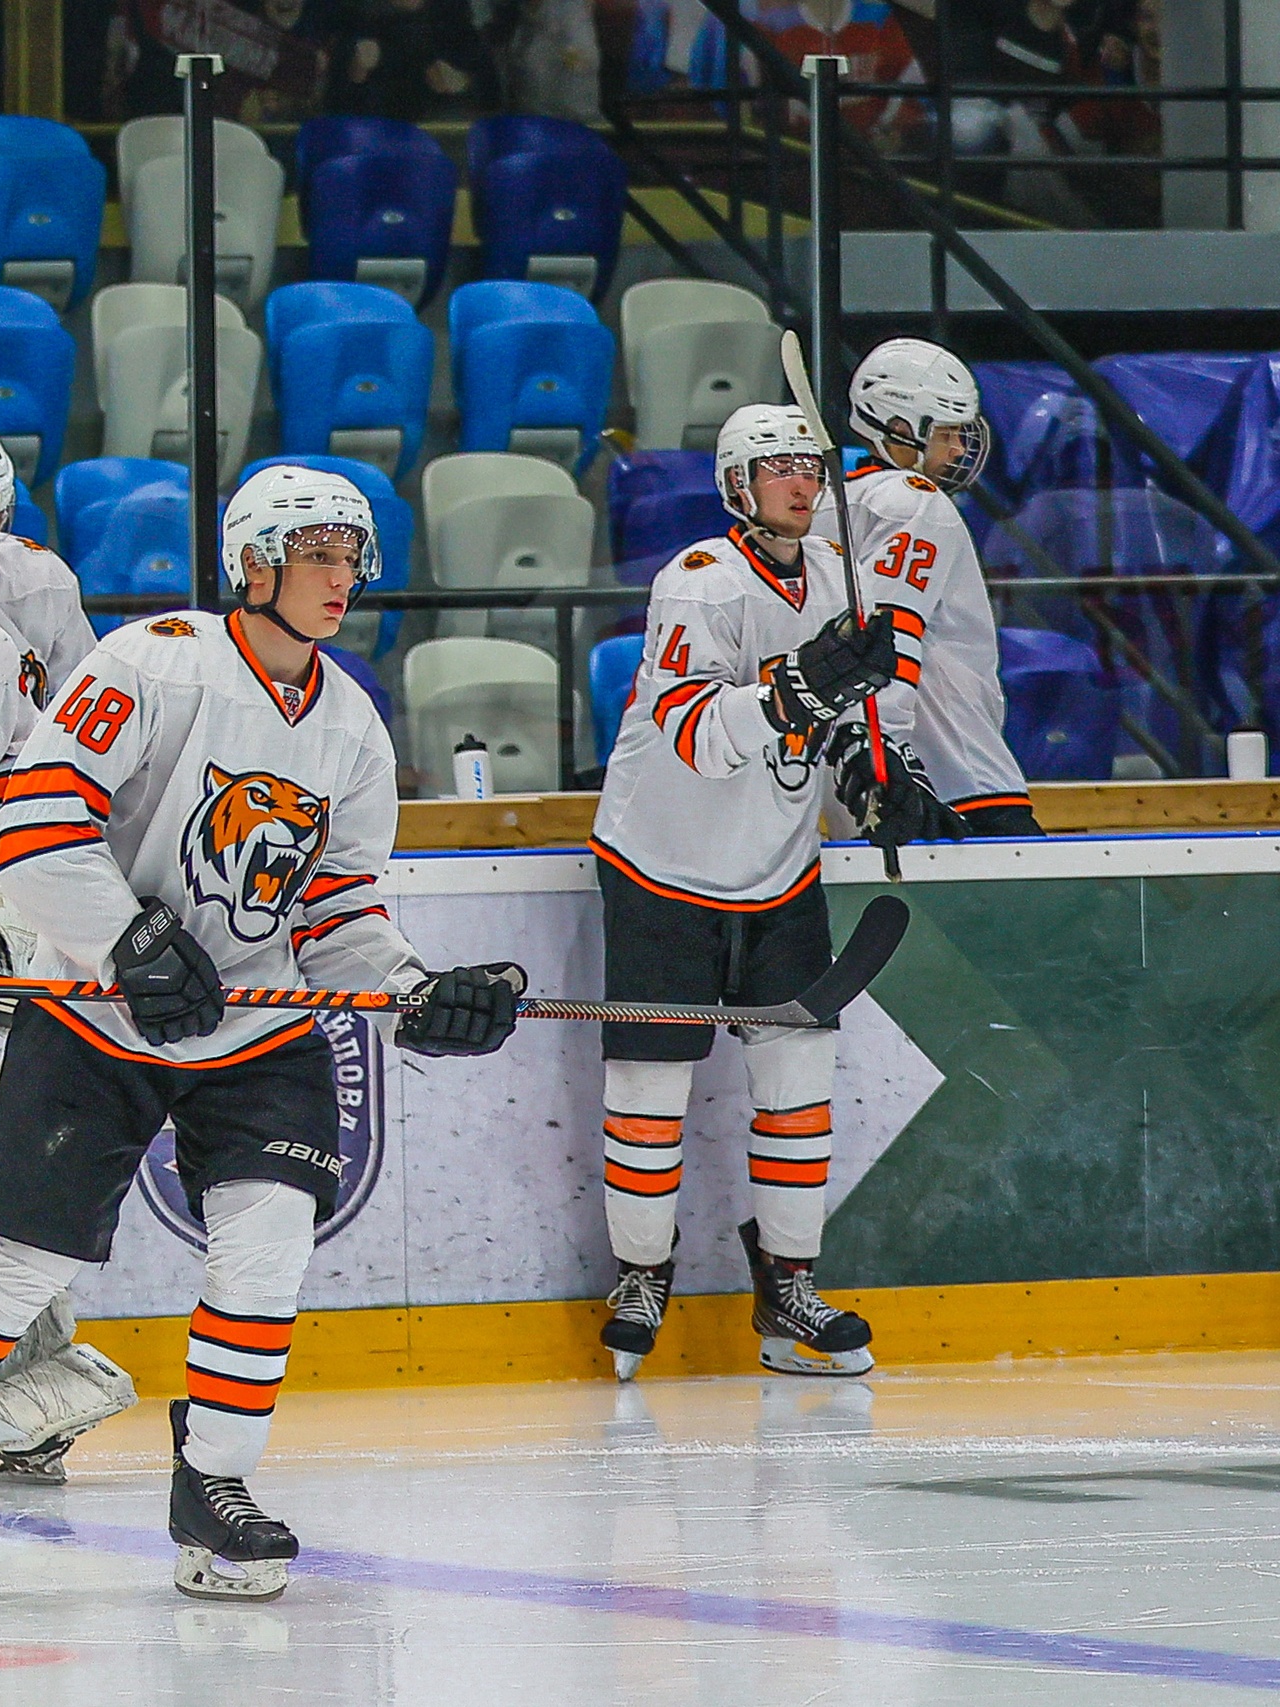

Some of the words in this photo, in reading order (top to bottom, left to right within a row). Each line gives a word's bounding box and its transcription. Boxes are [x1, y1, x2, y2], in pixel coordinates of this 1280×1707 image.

[873, 531, 938, 594] 32
[652, 622, 691, 678] 4
[52, 673, 136, 756] 48
[261, 1140, 344, 1178] BAUE
